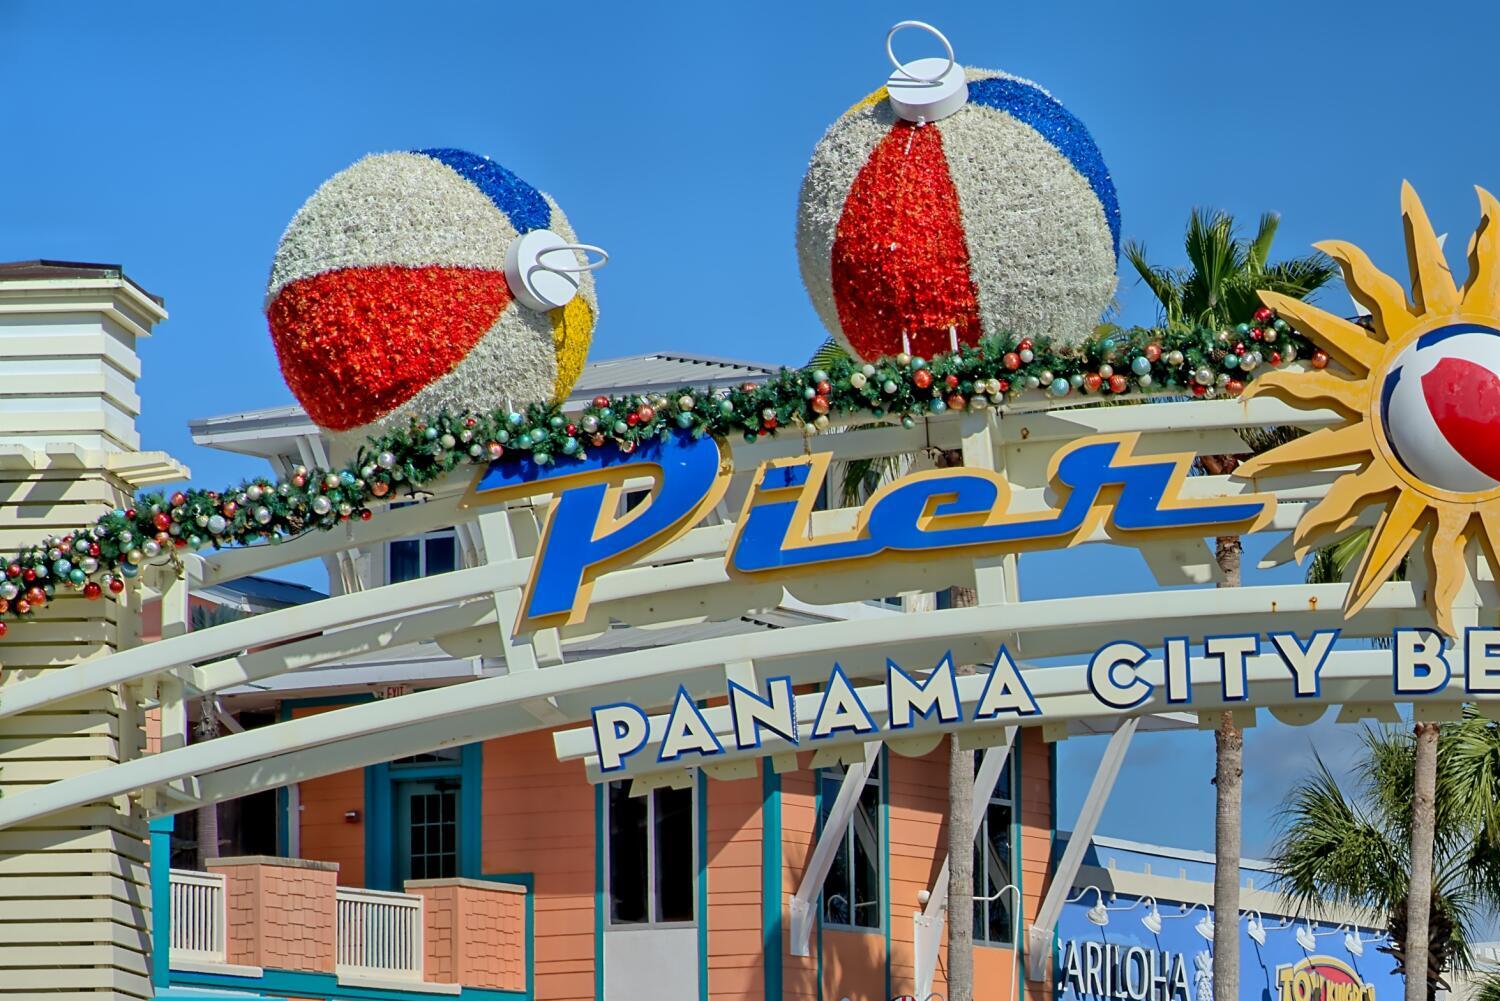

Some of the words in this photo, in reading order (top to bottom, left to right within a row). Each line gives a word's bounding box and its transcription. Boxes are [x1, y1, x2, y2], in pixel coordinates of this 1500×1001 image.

[470, 430, 1276, 634] Pier
[592, 645, 1042, 773] PANAMA
[1087, 629, 1342, 709] CITY
